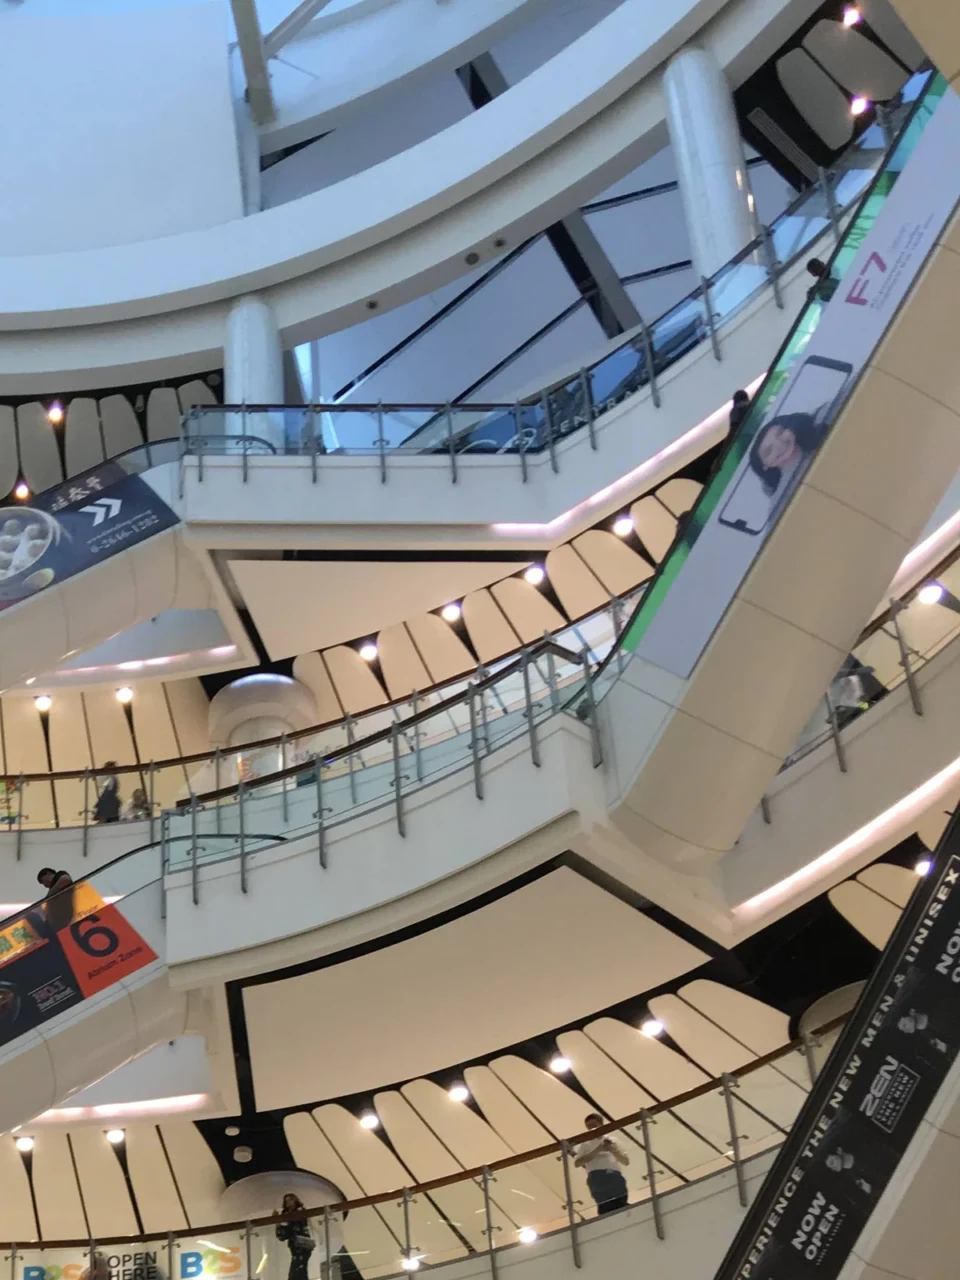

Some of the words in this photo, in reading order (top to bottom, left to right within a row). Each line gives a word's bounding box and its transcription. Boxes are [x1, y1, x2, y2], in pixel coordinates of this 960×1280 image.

[844, 251, 887, 306] F7
[70, 913, 120, 957] 6
[118, 947, 143, 962] Zone
[801, 1113, 835, 1160] THE
[829, 1055, 863, 1109] NEW
[861, 995, 895, 1048] MEN
[904, 868, 960, 963] UNISEX
[858, 1054, 900, 1118] ZEN
[791, 1191, 828, 1251] NOW
[804, 1203, 841, 1261] OPEN
[107, 1251, 157, 1269] OPEN
[180, 1246, 241, 1280] B2S
